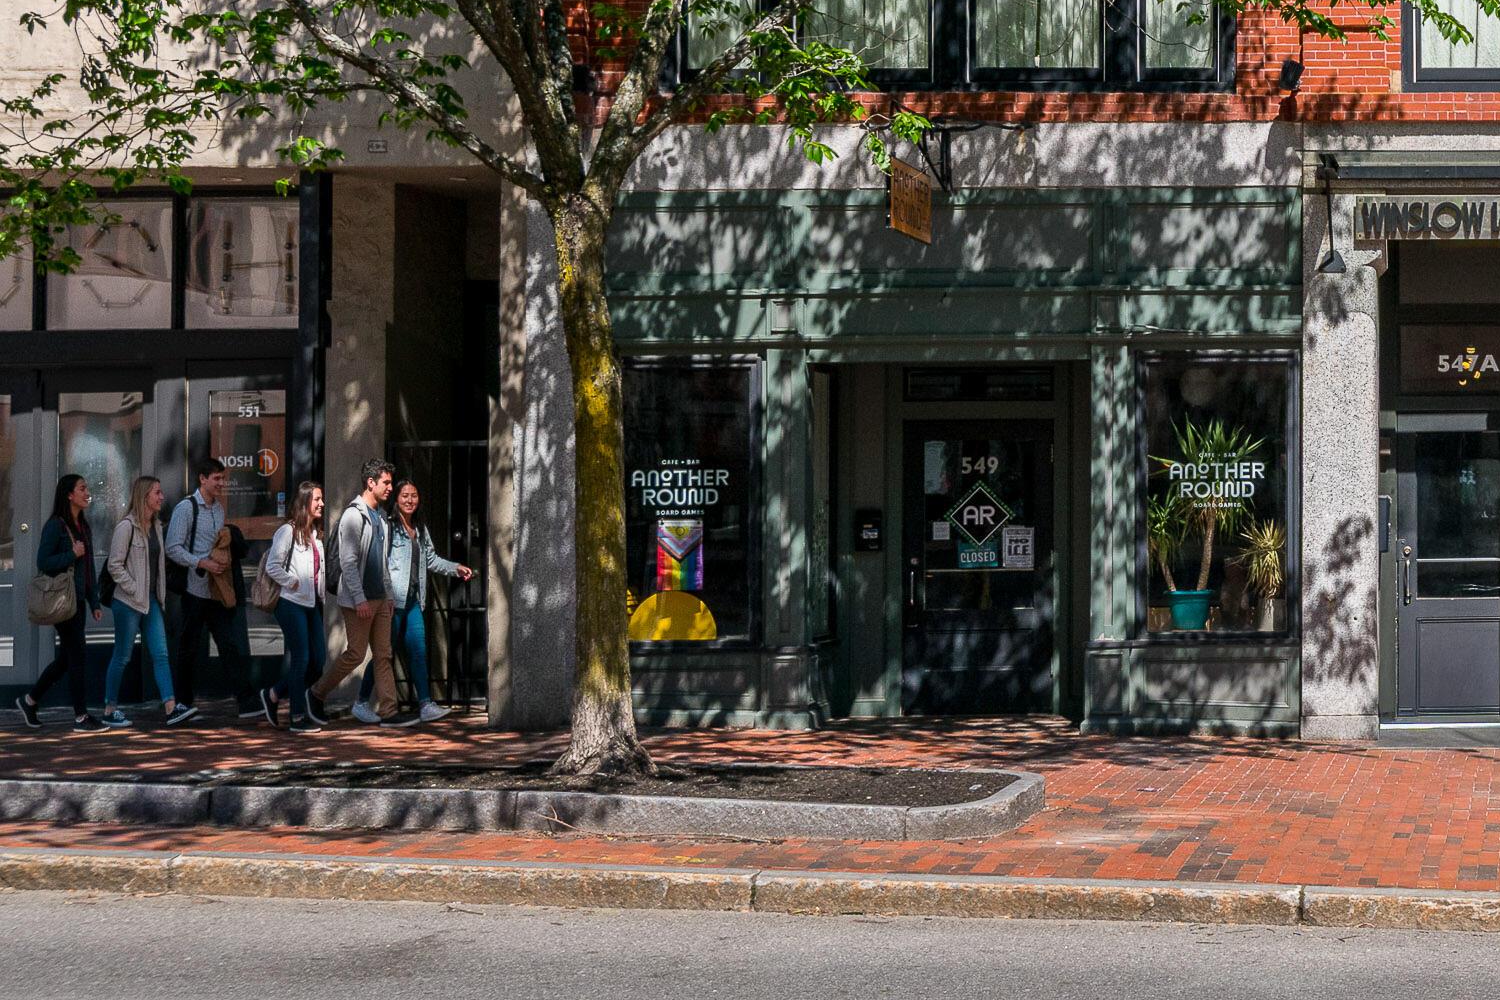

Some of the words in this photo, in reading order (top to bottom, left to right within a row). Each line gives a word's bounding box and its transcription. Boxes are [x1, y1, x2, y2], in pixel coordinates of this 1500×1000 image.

[1361, 201, 1485, 238] WINSLOW
[1437, 354, 1500, 373] 547A
[238, 406, 259, 418] 551
[218, 456, 253, 468] NOSH
[961, 456, 999, 474] 549
[1169, 462, 1265, 479] ANOTHER
[631, 469, 729, 487] ANOTHER
[642, 488, 719, 506] ROUND
[1180, 481, 1255, 498] ROUND
[963, 505, 996, 525] AR
[960, 551, 996, 563] CLOSED
[1008, 545, 1031, 557] ICE
